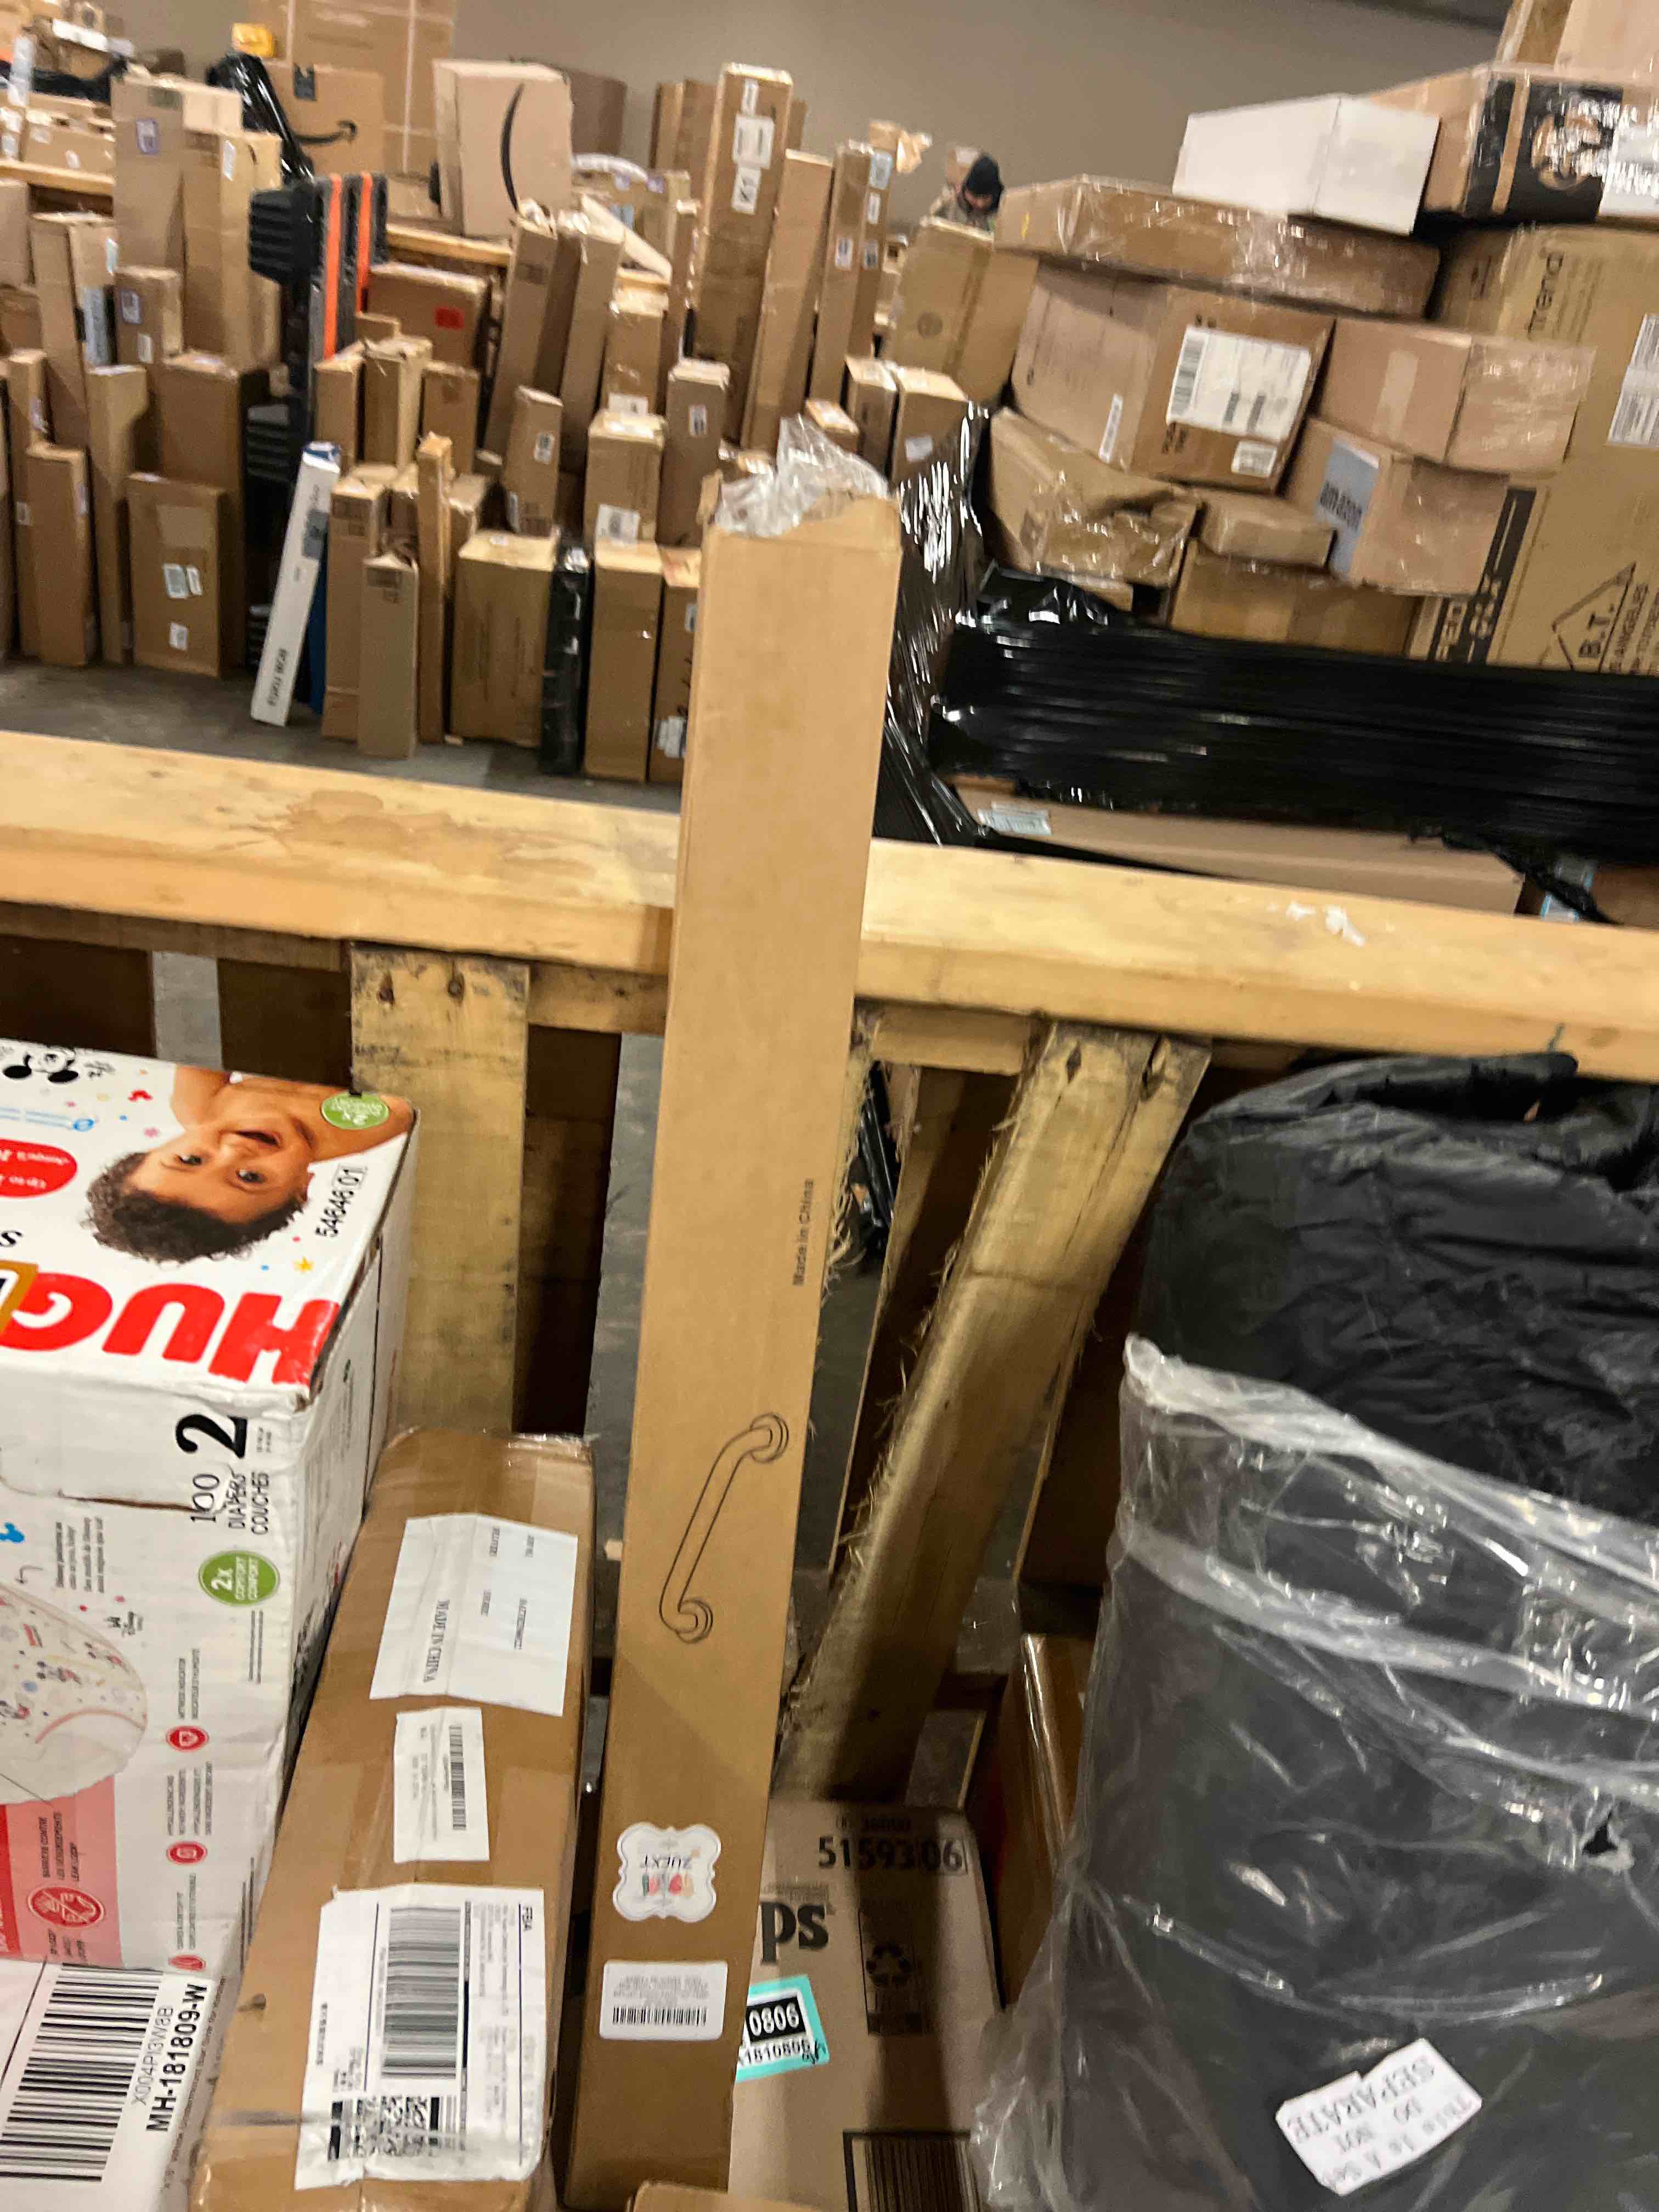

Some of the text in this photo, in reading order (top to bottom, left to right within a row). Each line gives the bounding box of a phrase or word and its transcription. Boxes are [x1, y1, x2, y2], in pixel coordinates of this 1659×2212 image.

[799, 1178, 814, 1224] China
[175, 1414, 247, 1459] 2
[190, 1473, 221, 1523] 100
[225, 1473, 246, 1528] DIAPERS
[250, 1471, 269, 1535] COUCHES
[749, 2002, 800, 2036] 0806
[146, 1983, 208, 2132] MH-181809-W
[1287, 2056, 1436, 2144] SEPARATE
